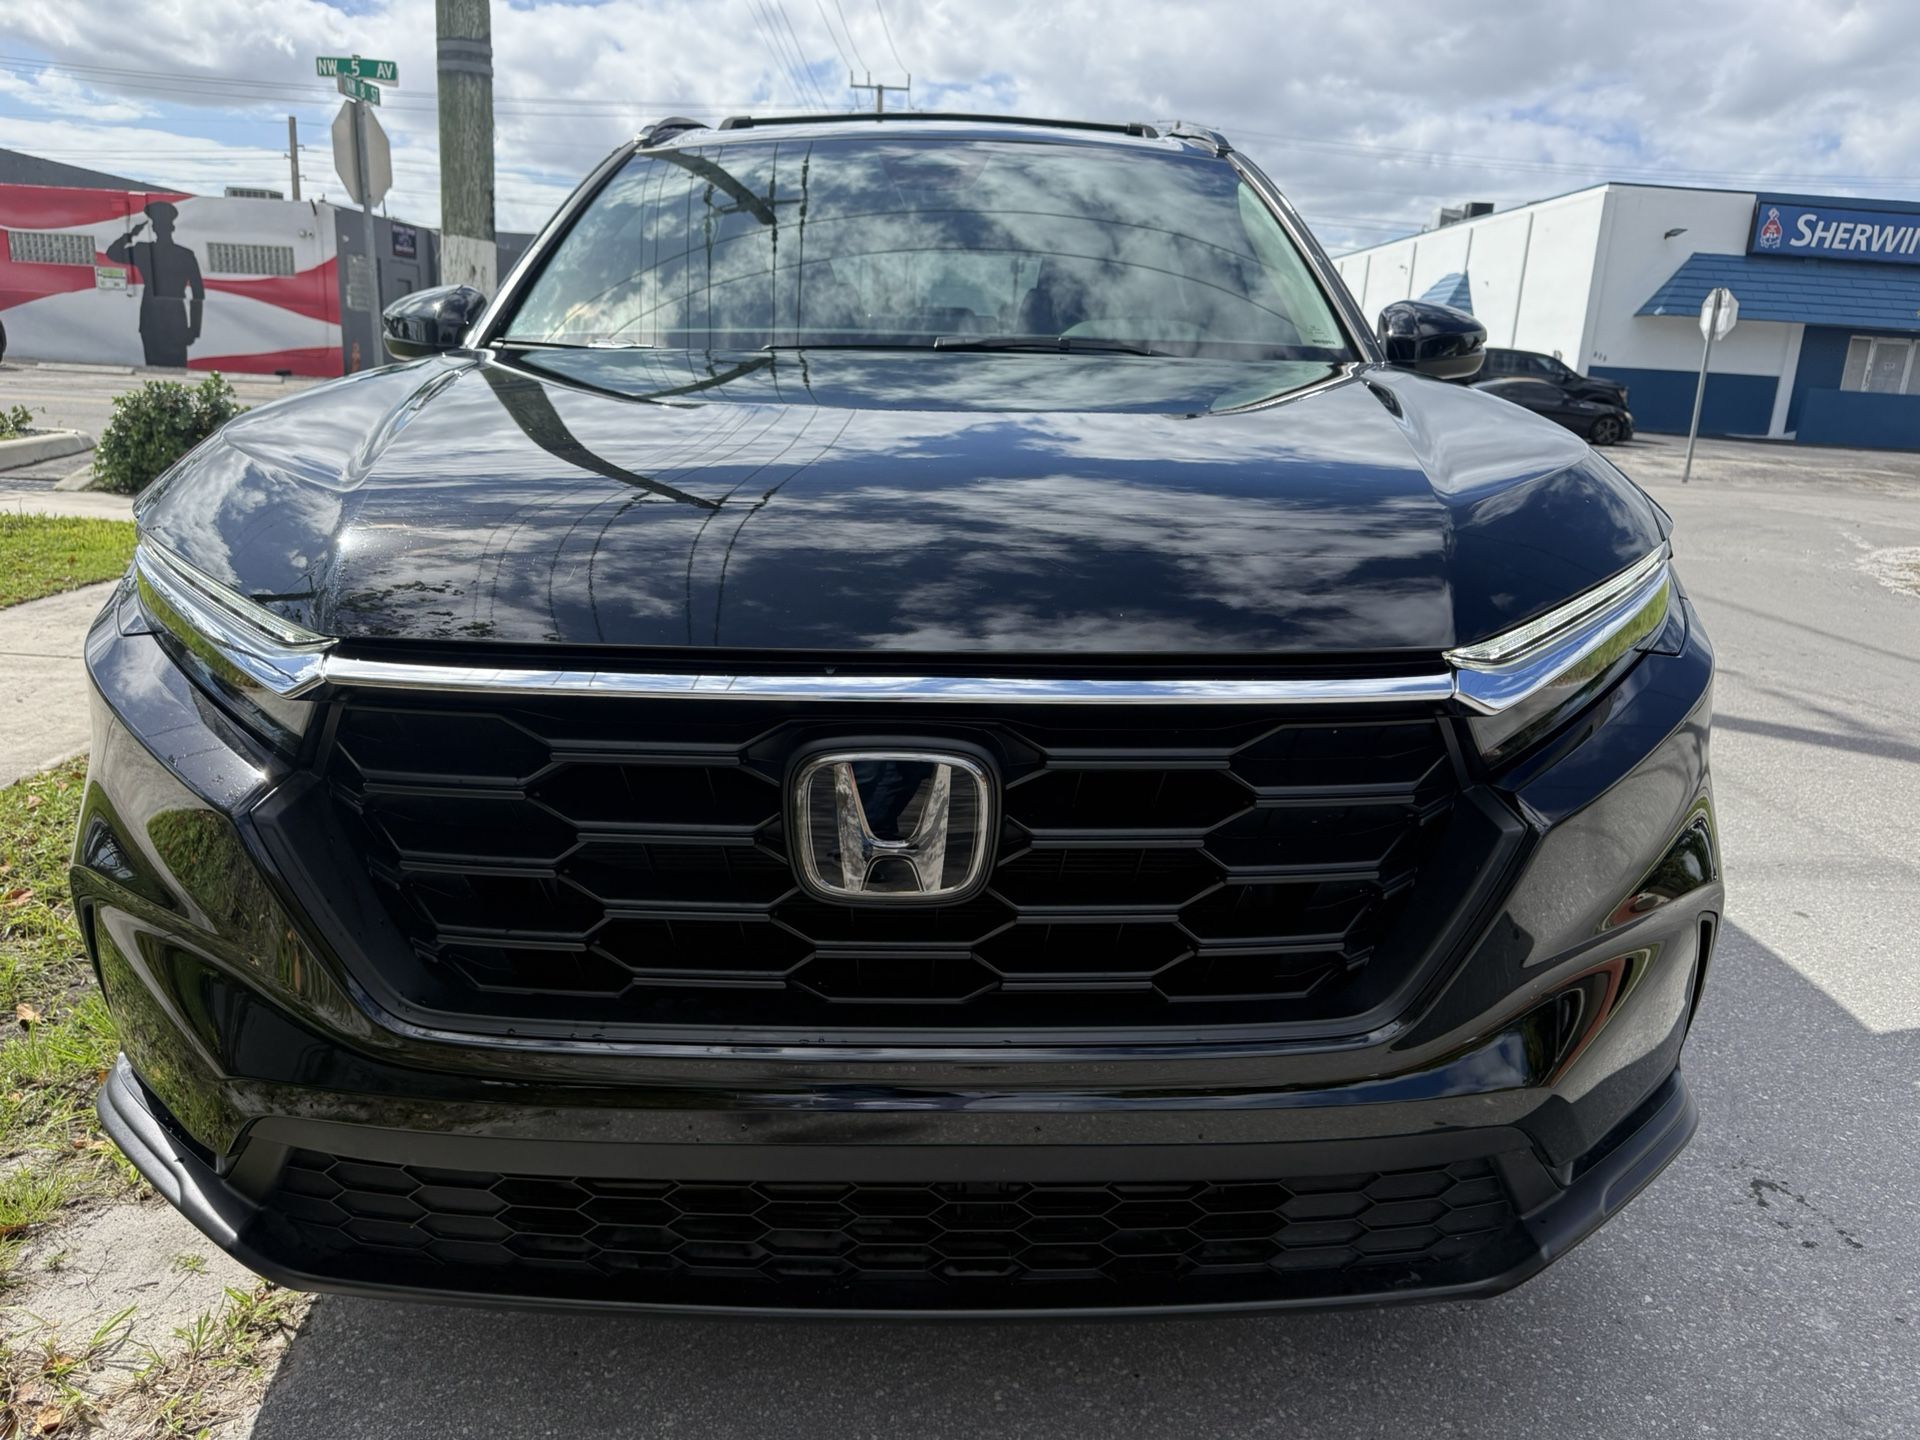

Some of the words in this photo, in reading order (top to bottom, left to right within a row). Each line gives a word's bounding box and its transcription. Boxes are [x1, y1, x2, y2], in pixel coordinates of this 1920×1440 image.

[318, 59, 337, 75] NW
[351, 60, 360, 76] 5
[376, 62, 393, 78] AV
[370, 87, 378, 103] ST
